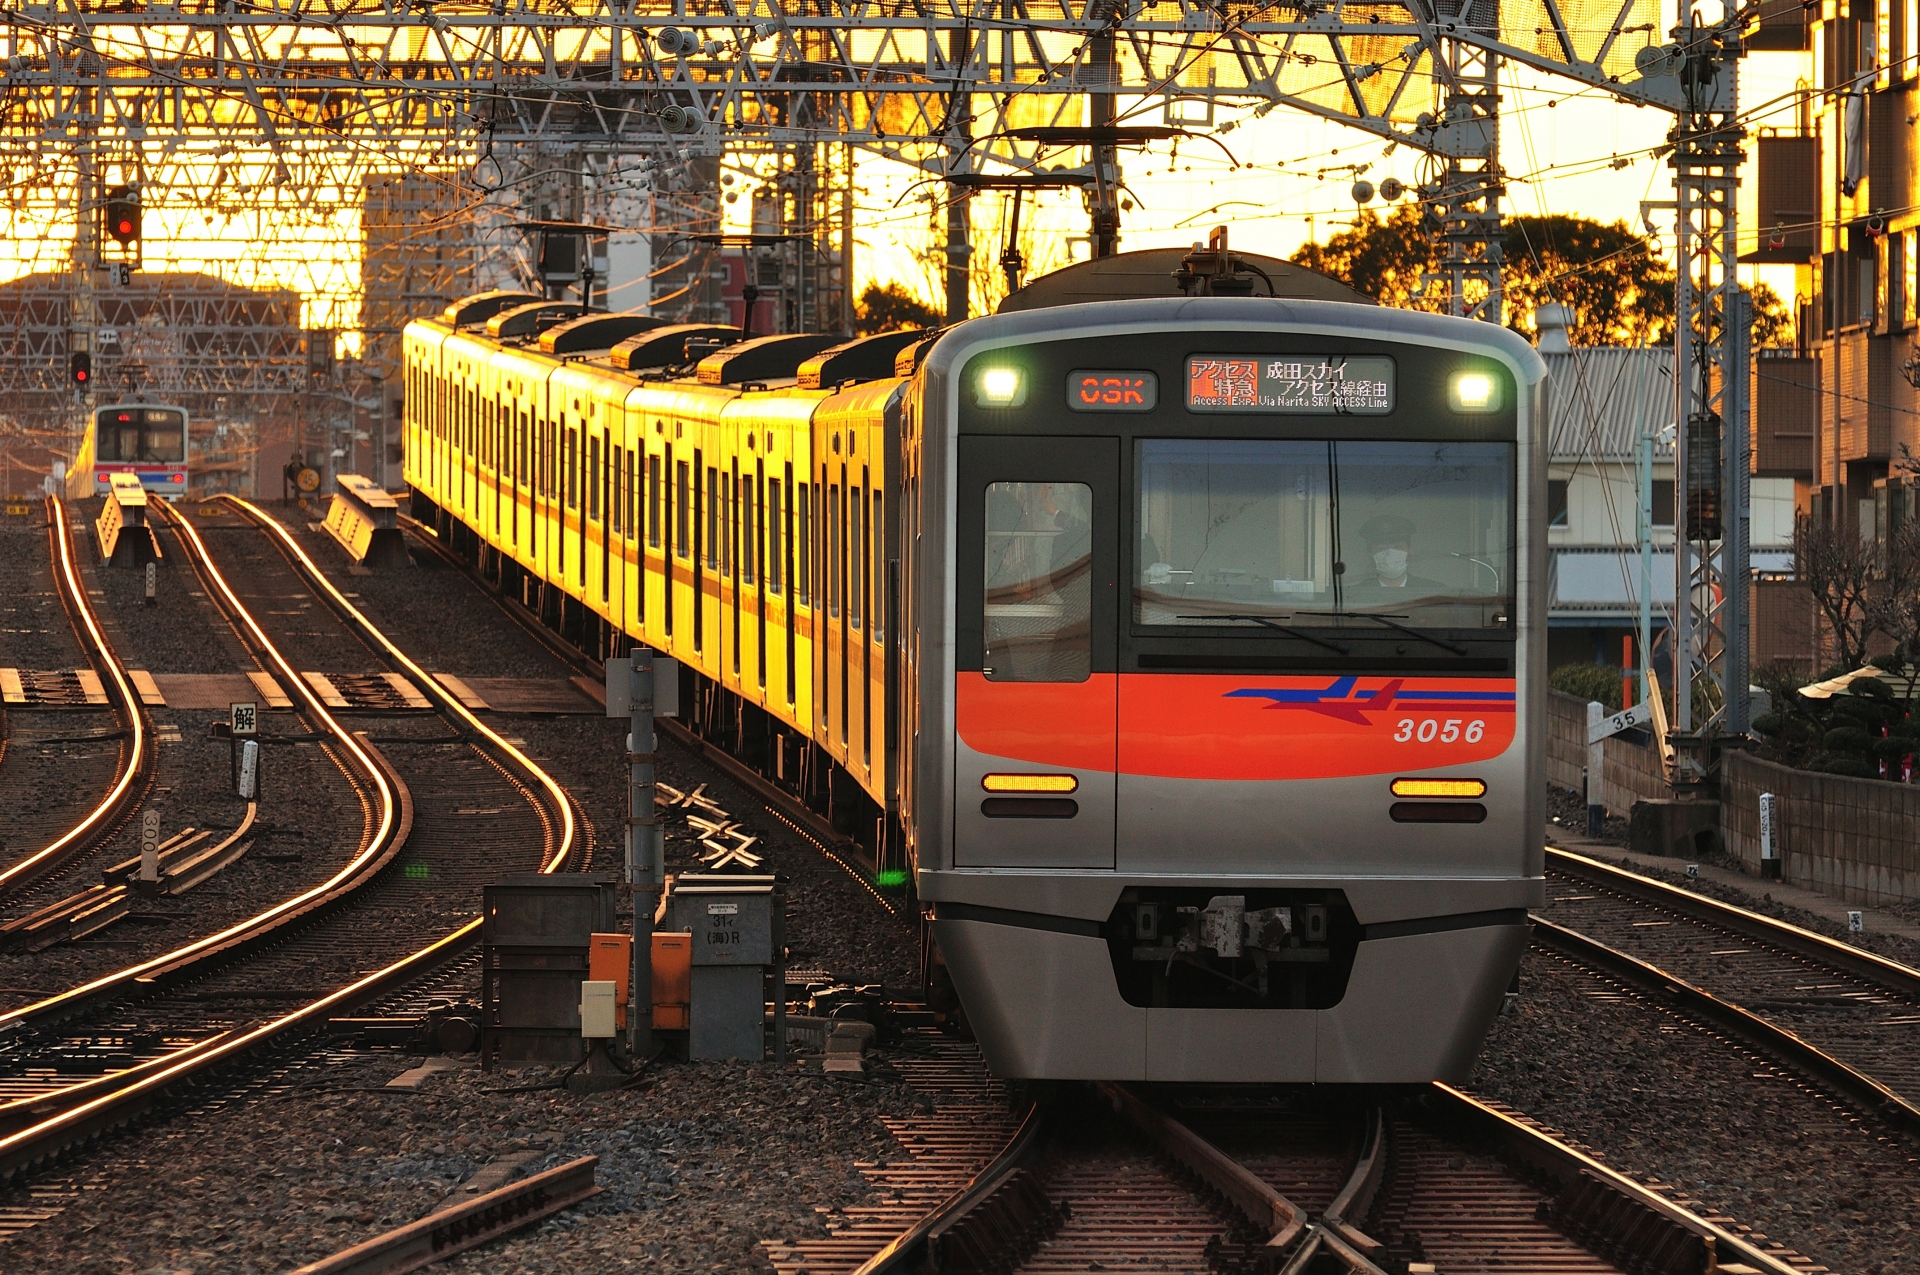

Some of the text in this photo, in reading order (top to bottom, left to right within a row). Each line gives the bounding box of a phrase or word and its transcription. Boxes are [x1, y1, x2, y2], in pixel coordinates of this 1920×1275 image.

[1191, 360, 1255, 379] アクセス
[1266, 361, 1348, 380] 成田スカイ
[1214, 379, 1255, 397] 特急
[1280, 380, 1387, 397] アクセス線経由
[1193, 396, 1228, 406] Access
[1258, 396, 1275, 407] Via
[1277, 396, 1309, 407] Narita
[1311, 397, 1330, 407] SKY
[1332, 396, 1366, 408] ACCESS
[1368, 397, 1388, 408] Line
[234, 707, 255, 730] 解
[1613, 711, 1635, 730] 35
[1393, 718, 1486, 743] 3056
[142, 815, 158, 852] 300
